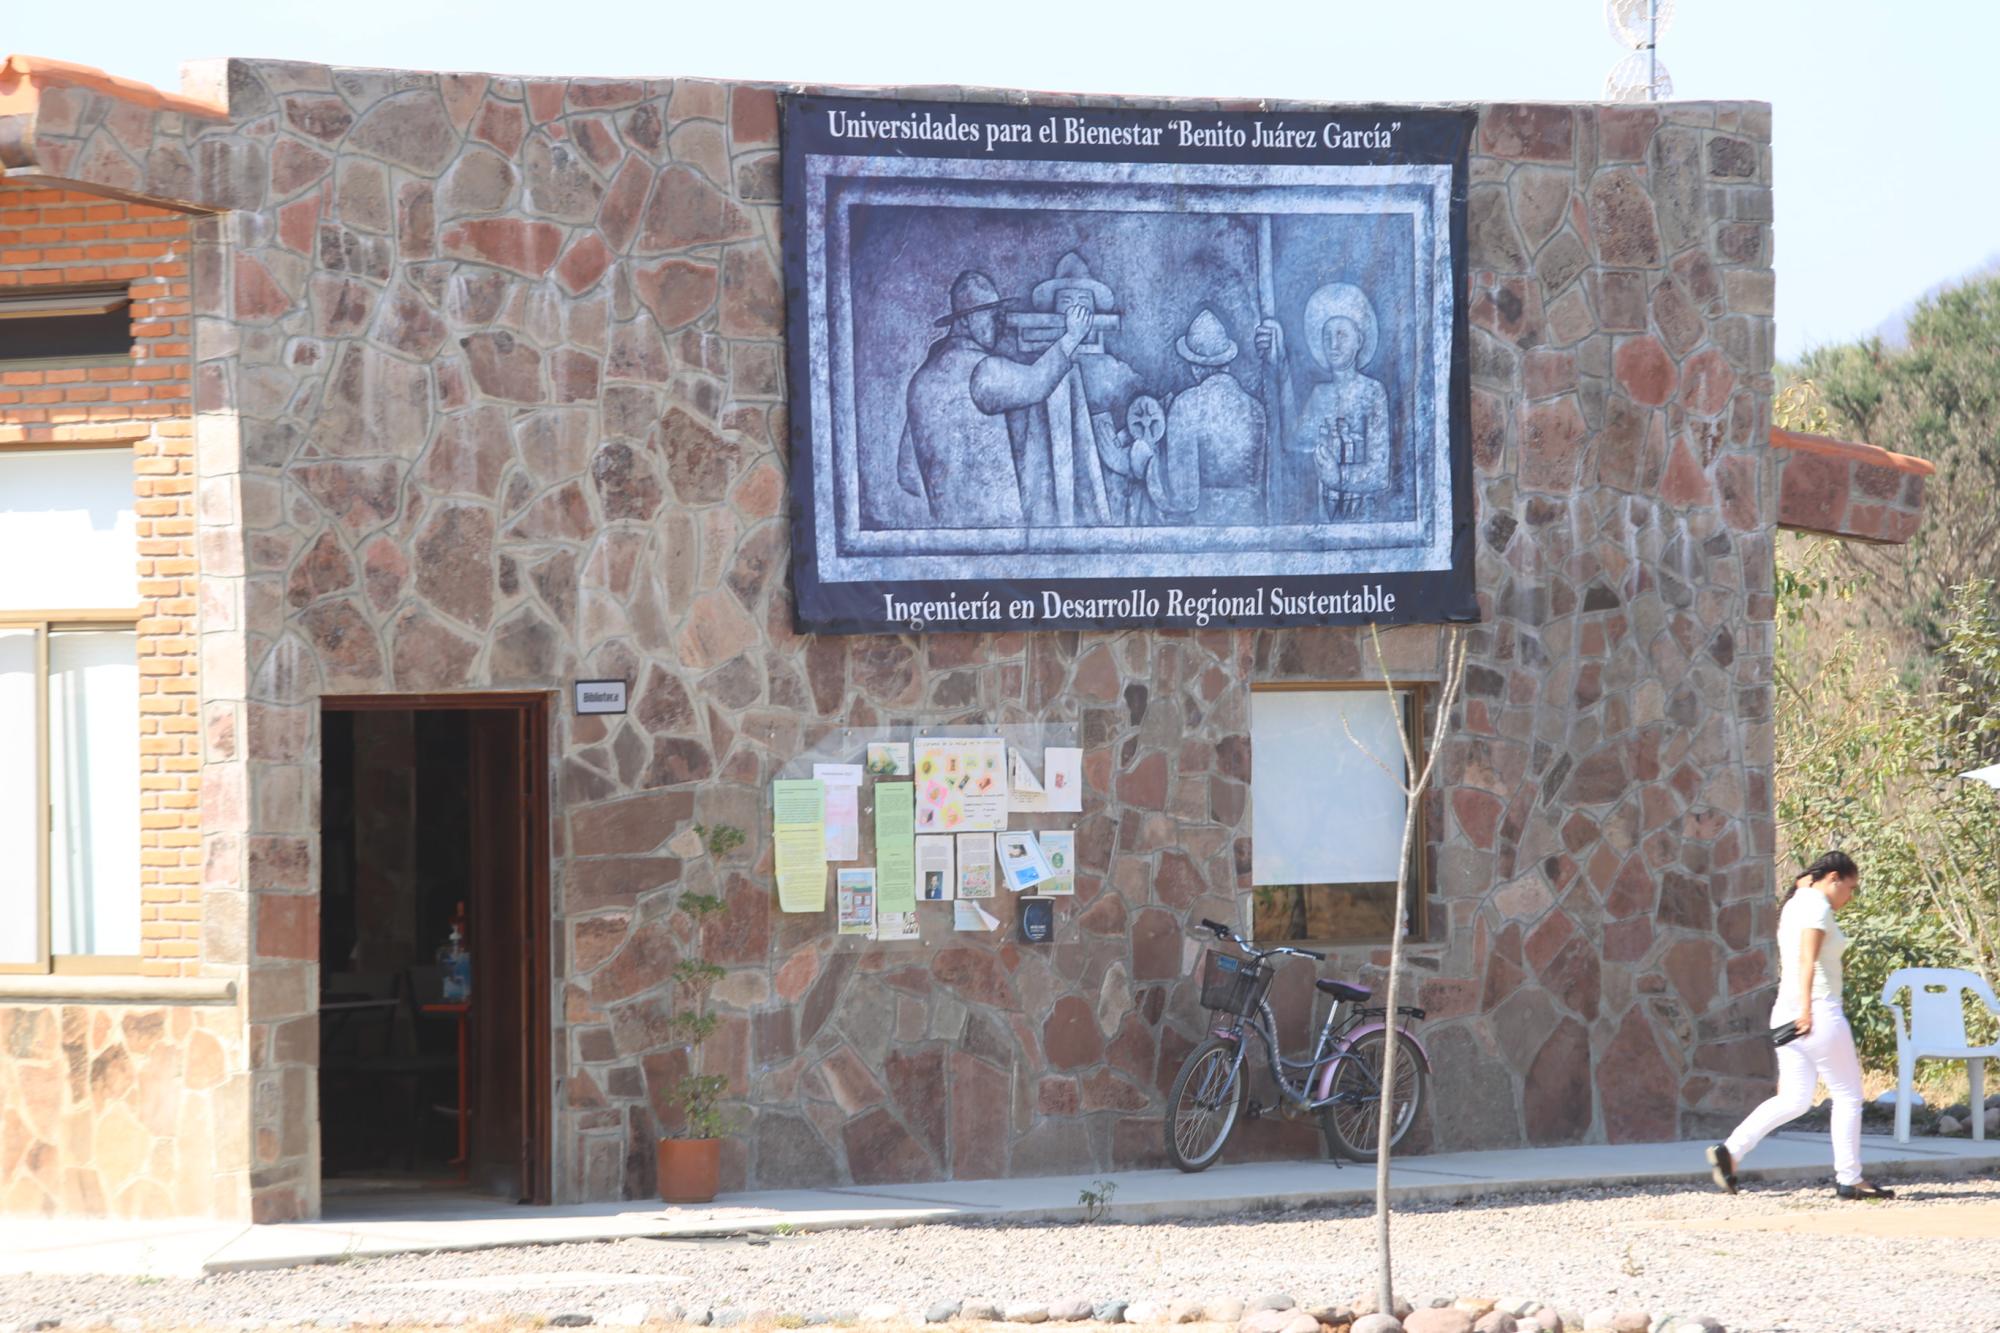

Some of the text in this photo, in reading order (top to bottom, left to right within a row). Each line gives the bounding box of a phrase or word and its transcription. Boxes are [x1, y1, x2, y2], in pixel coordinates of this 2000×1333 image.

[828, 110, 1401, 151] Universidades para el Bienestar “Benito Juárez García”
[883, 585, 1396, 631] Ingeniería en Desarrollo Regional Sustentable
